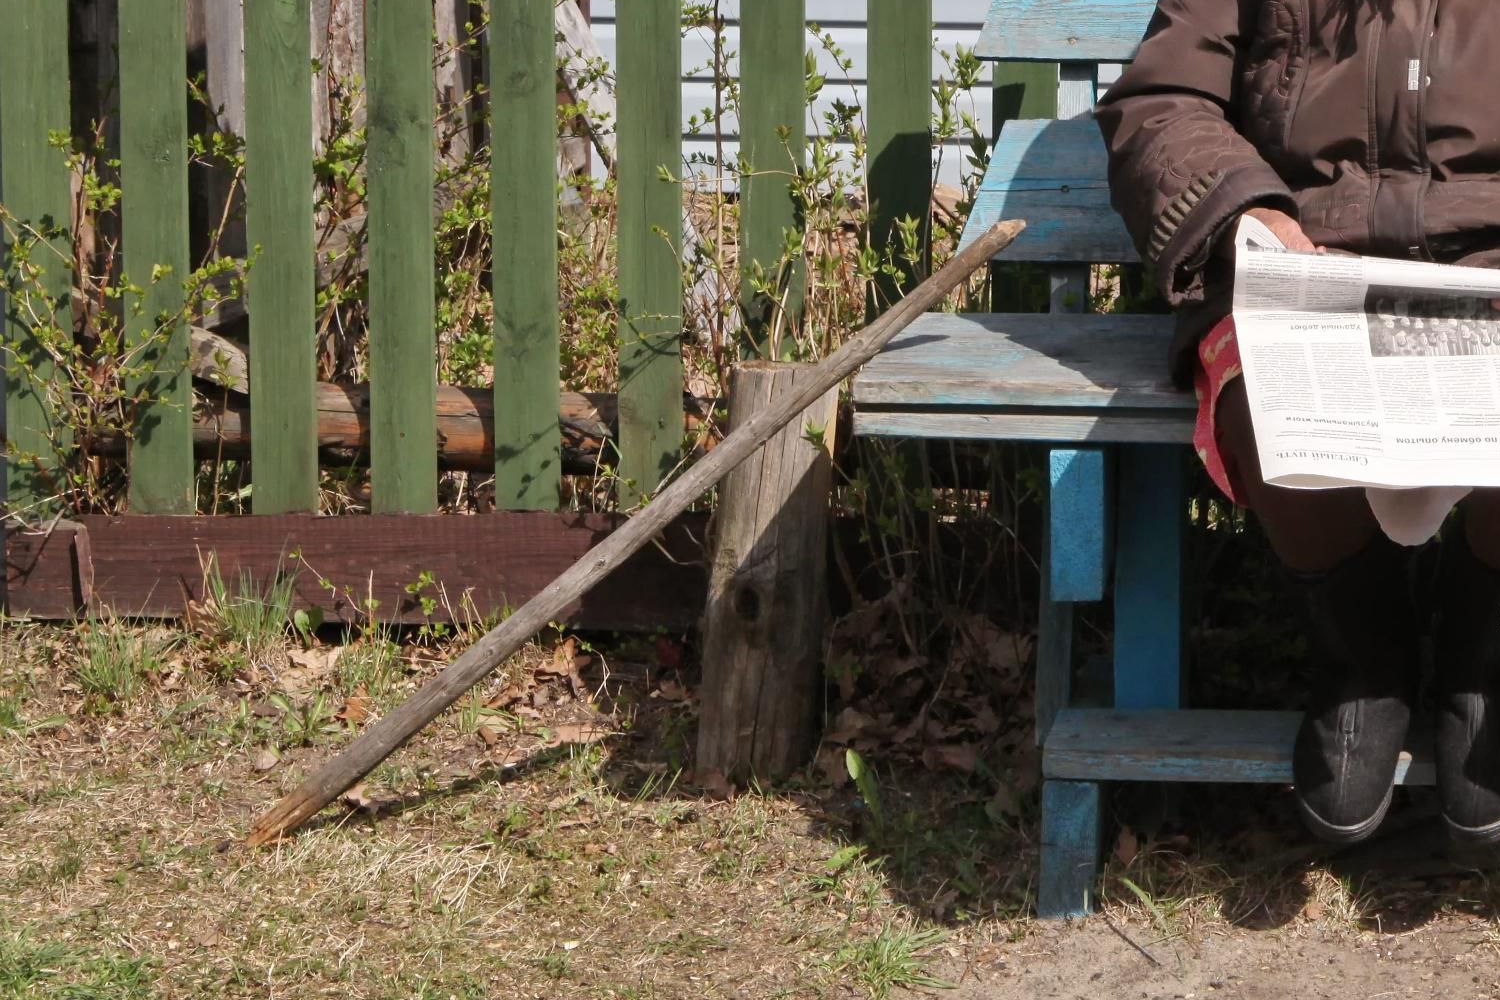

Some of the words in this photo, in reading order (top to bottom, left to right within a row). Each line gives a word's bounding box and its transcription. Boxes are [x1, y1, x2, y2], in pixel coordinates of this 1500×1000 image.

[1289, 323, 1319, 332] дебют
[1320, 323, 1362, 333] Удачный
[1395, 436, 1438, 445] опытом
[1441, 435, 1482, 445] обмену
[1311, 451, 1369, 467] Светлый
